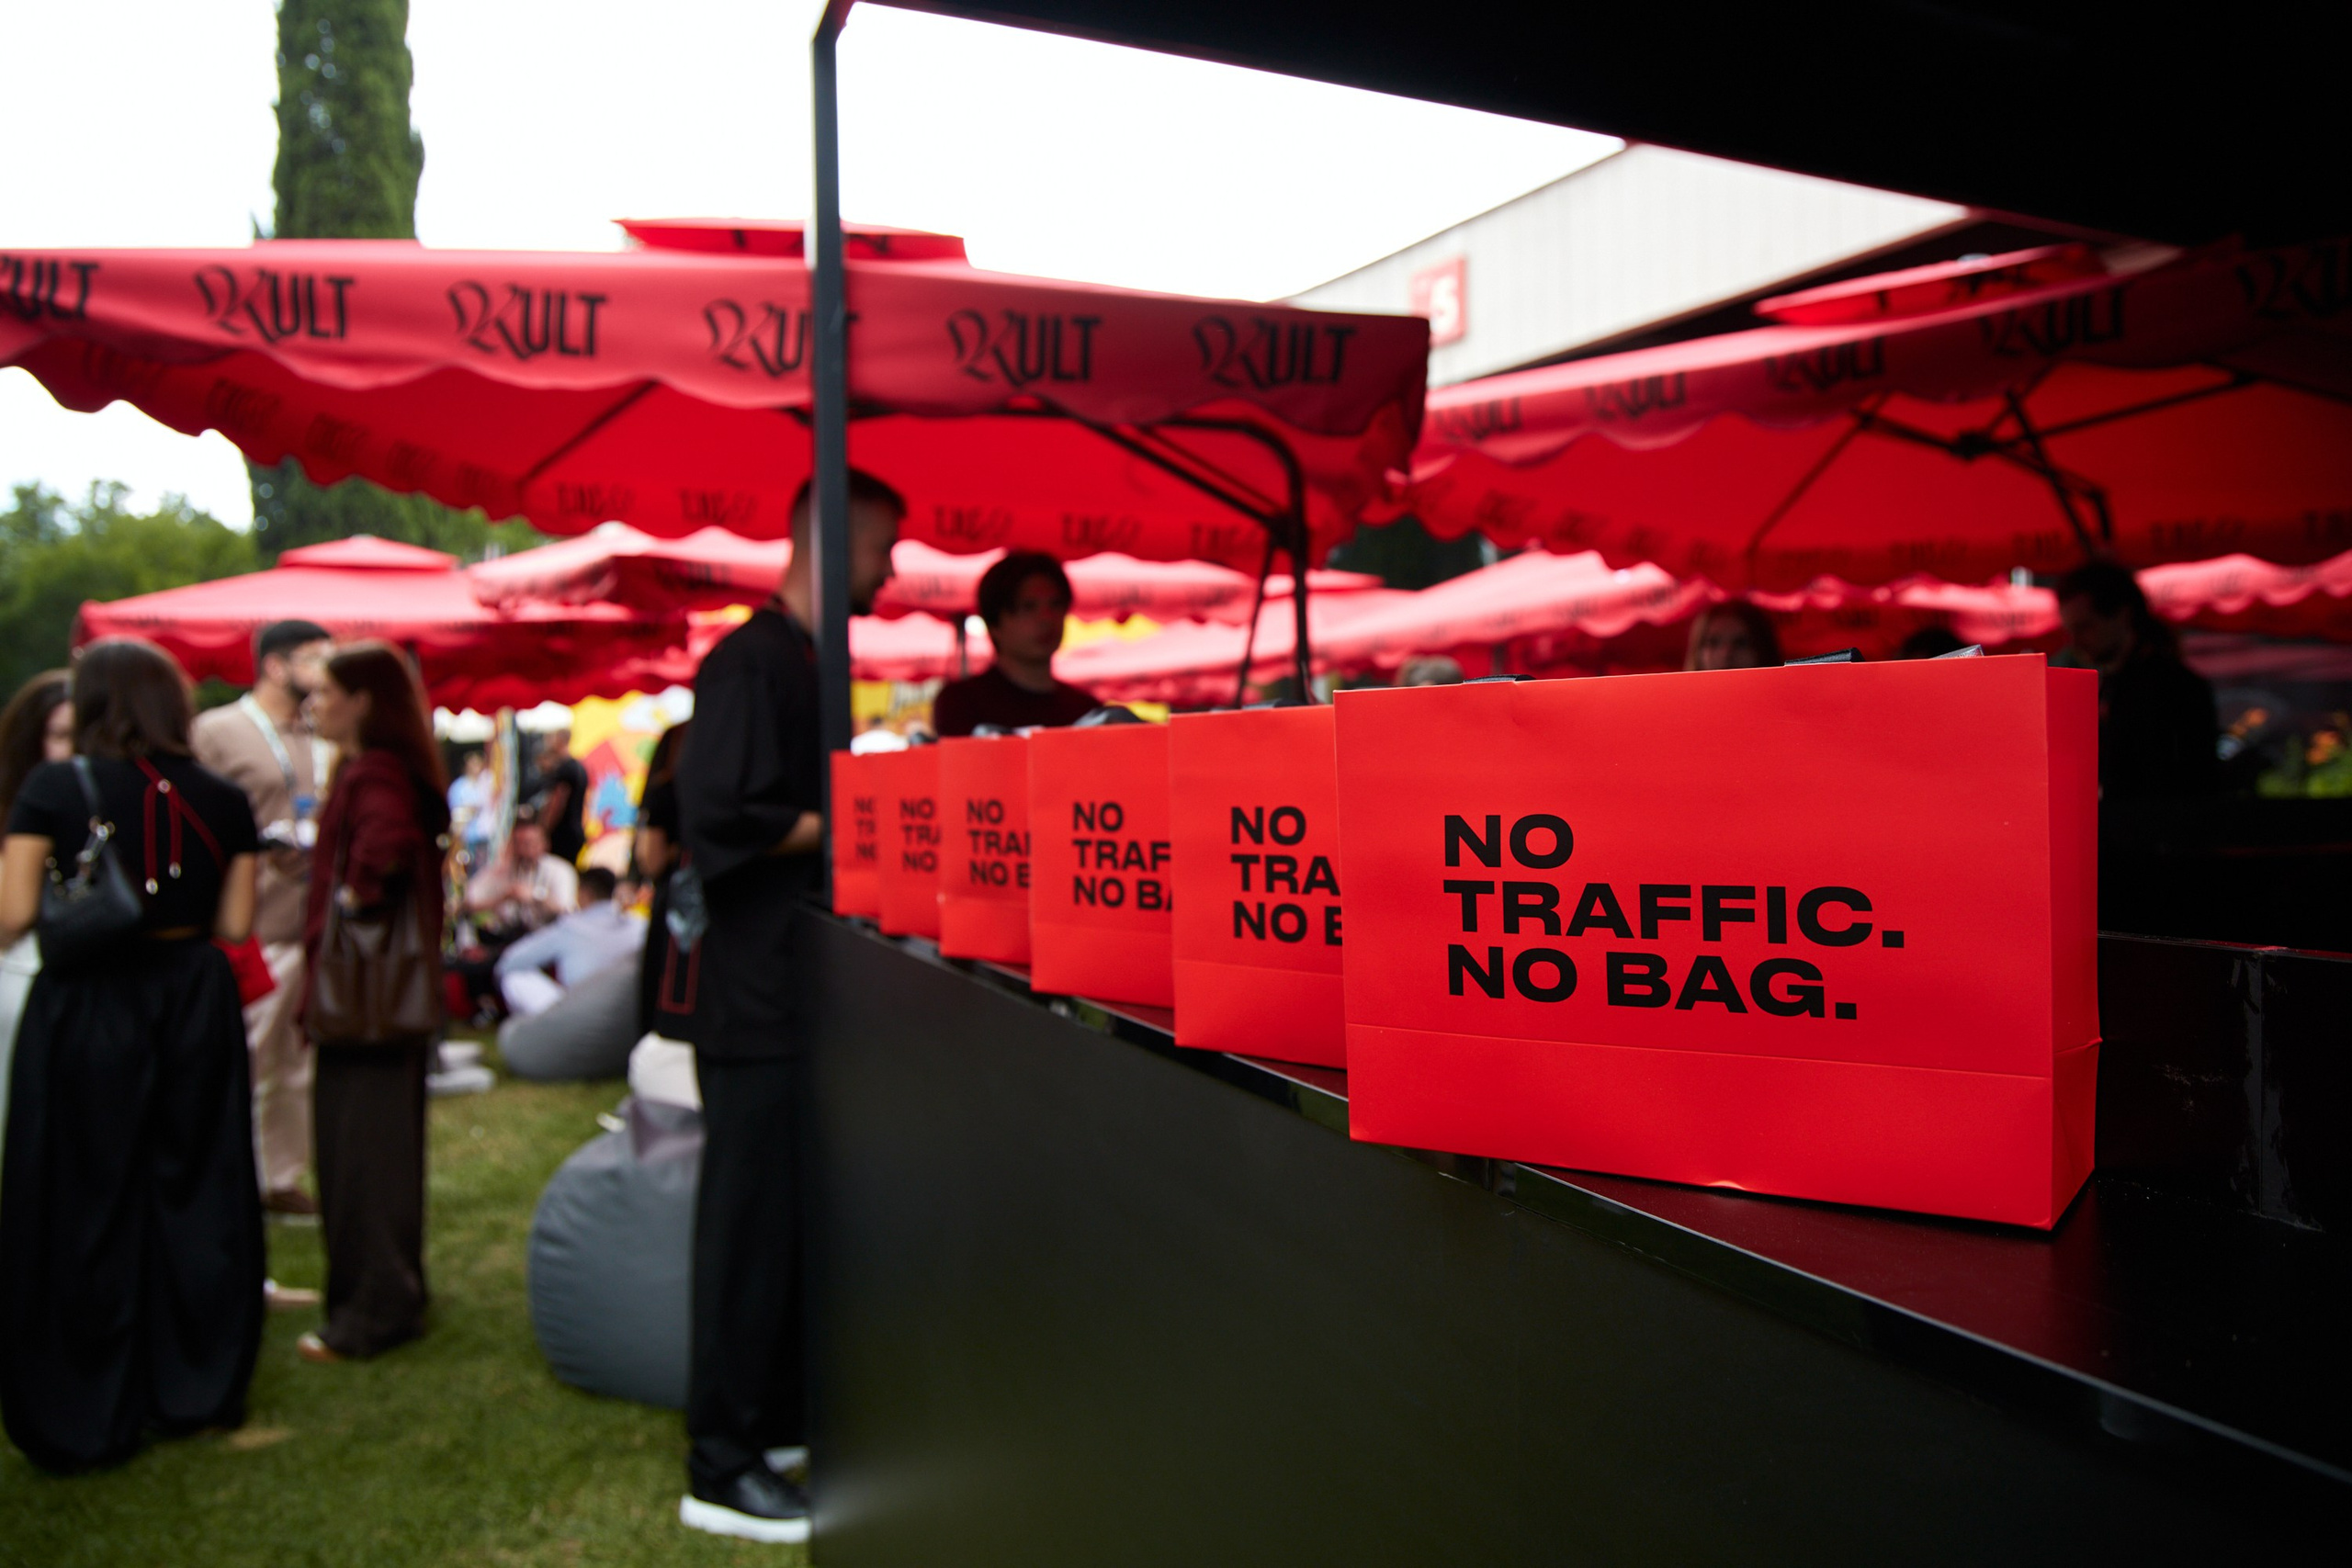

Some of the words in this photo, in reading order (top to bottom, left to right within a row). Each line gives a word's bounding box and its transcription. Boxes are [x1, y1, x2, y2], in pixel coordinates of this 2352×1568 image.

[194, 264, 356, 344] KULT
[447, 281, 607, 359] KULT
[946, 309, 1101, 388] KULT
[1193, 316, 1358, 390] KULT
[900, 797, 936, 820] NO
[967, 798, 1005, 826] NO
[1073, 802, 1125, 833] NO
[1231, 807, 1306, 846] NO
[1072, 839, 1171, 872] TRAF
[1444, 814, 1574, 869] NO
[902, 850, 938, 874] NO
[969, 860, 1010, 887] NO
[1231, 854, 1341, 897] TRA
[1074, 875, 1125, 908] NO
[1234, 901, 1308, 943] NO
[1443, 880, 1905, 949] TRAFFIC.
[1448, 944, 1577, 1003] NO
[1606, 952, 1858, 1020] BAG.
